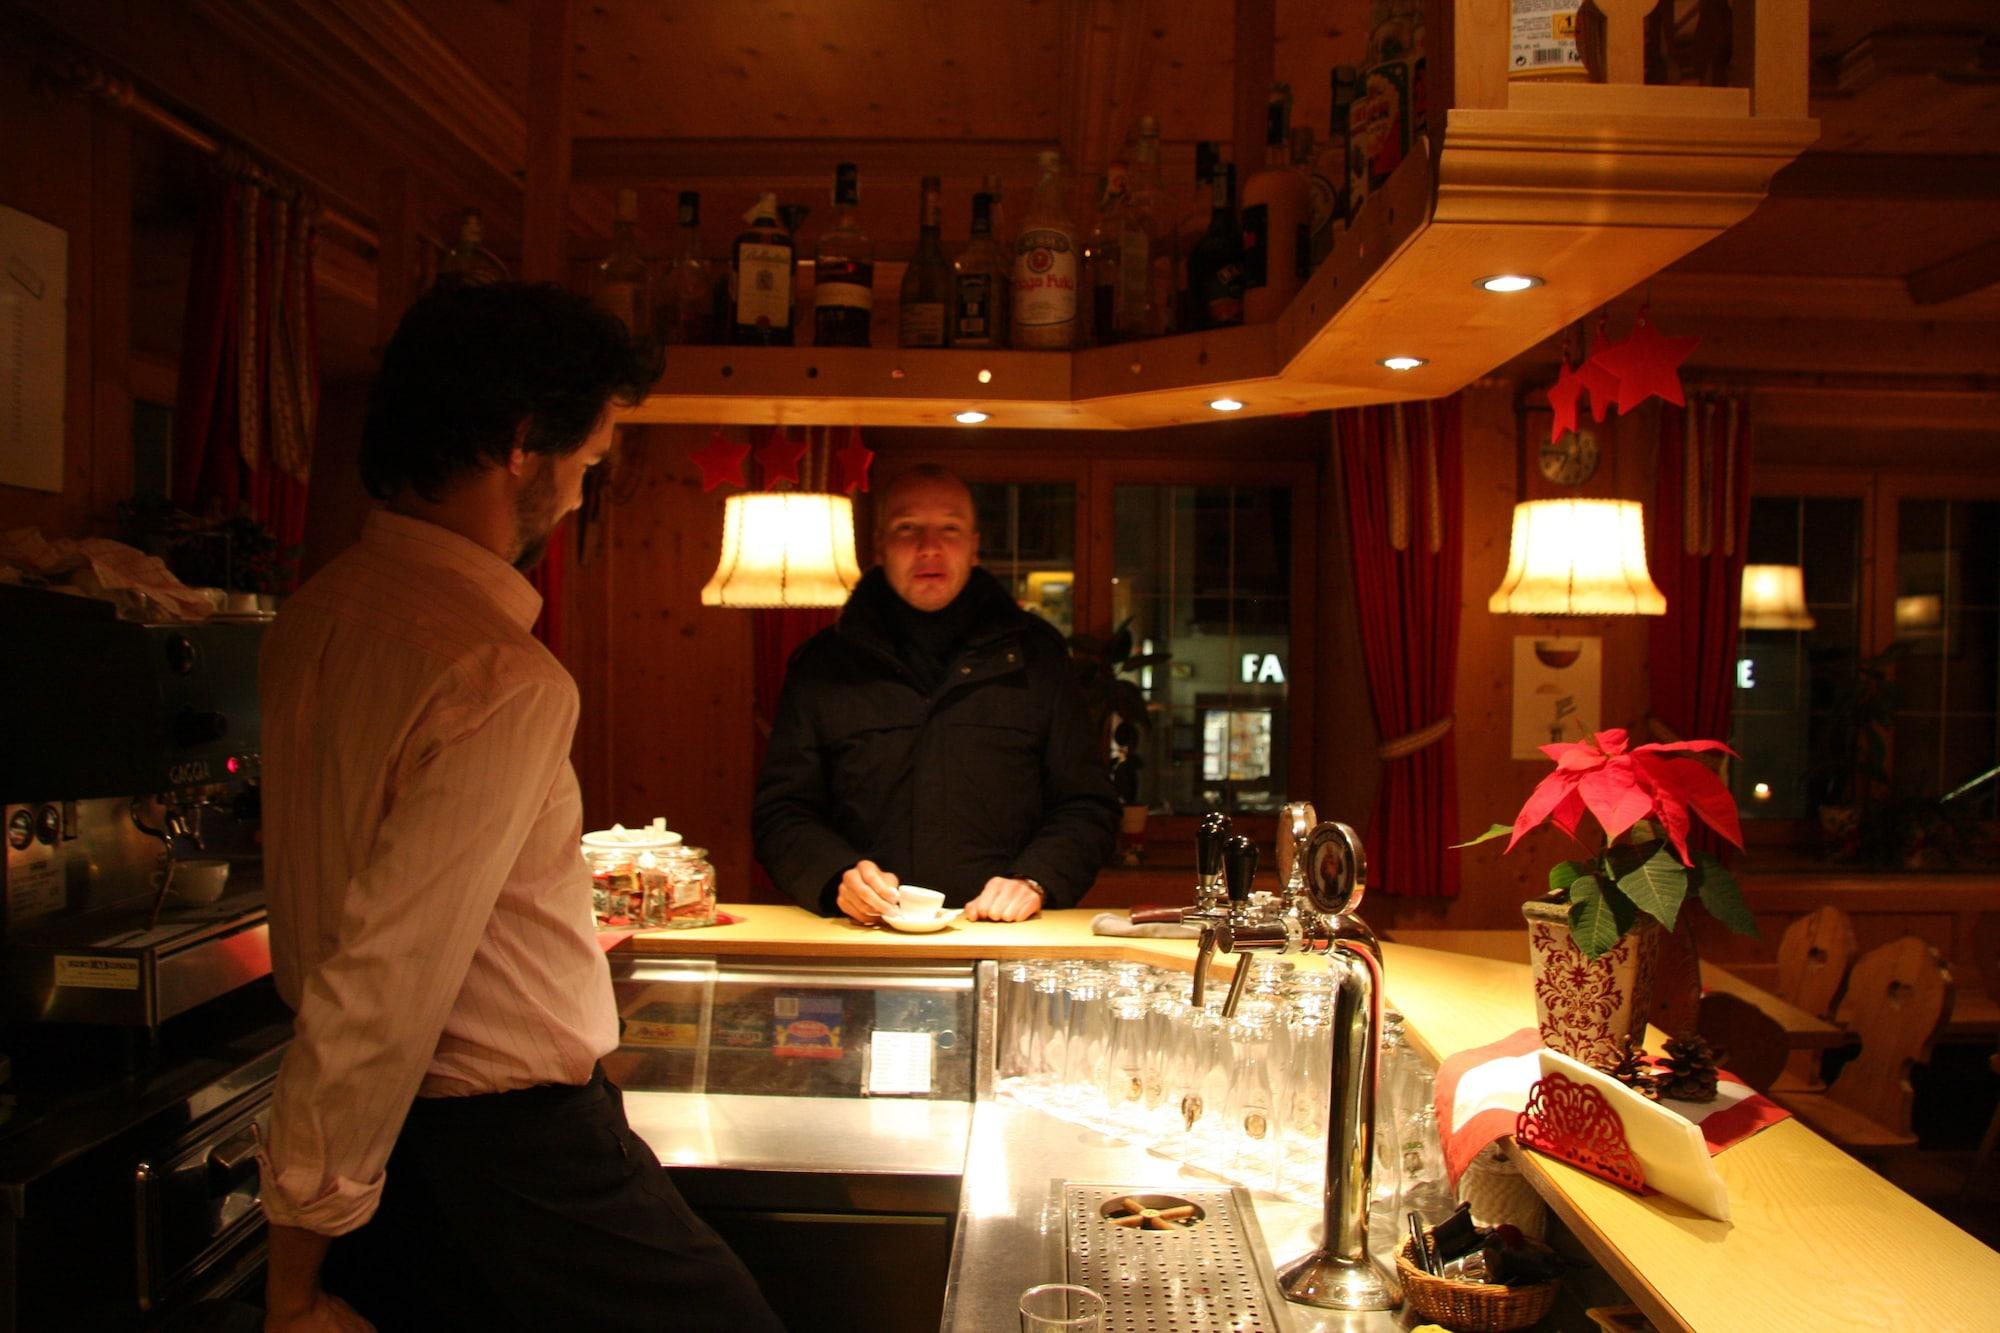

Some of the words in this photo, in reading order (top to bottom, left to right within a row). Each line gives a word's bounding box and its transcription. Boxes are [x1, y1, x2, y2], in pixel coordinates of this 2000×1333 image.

[1565, 15, 1572, 27] 1
[1241, 653, 1286, 684] FA
[1736, 659, 1756, 689] E
